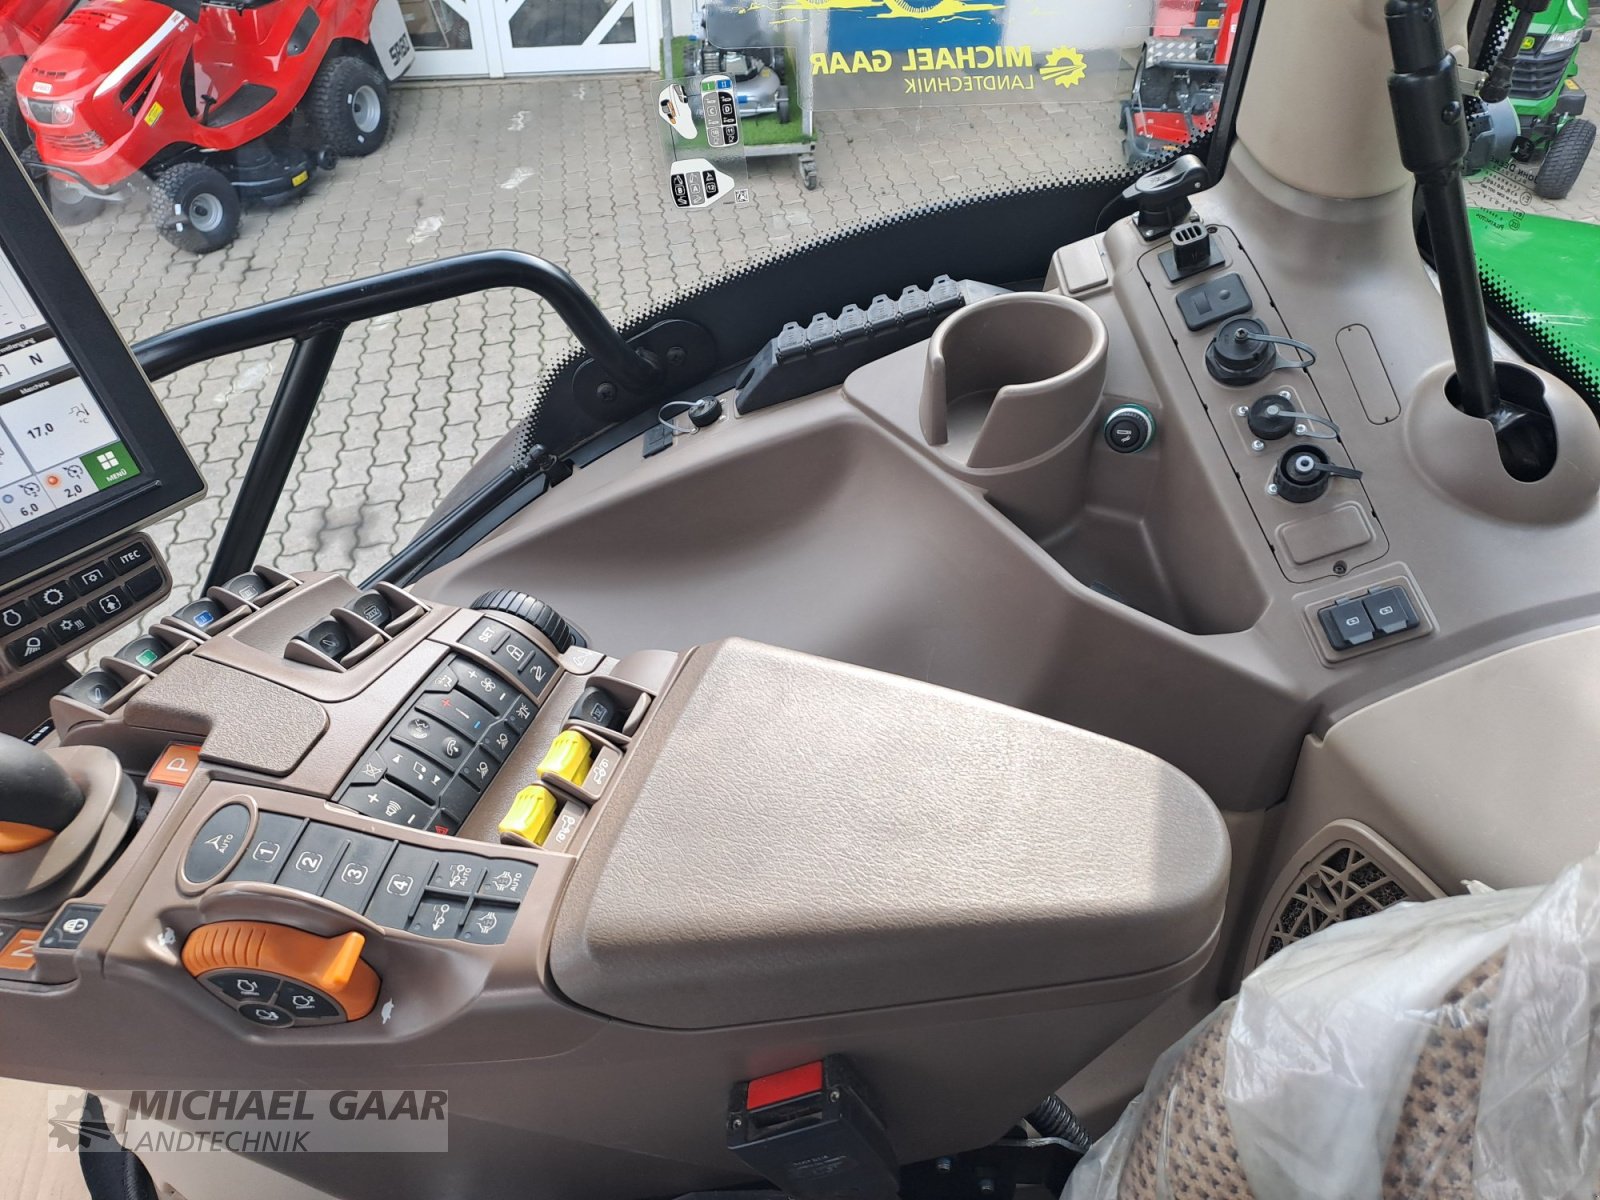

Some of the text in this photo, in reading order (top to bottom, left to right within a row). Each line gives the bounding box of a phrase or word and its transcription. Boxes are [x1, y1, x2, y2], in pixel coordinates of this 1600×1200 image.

[707, 184, 715, 192] 12
[29, 352, 43, 365] N
[20, 380, 50, 395] Maschine
[27, 423, 54, 439] 17,0
[106, 469, 127, 483] MENÜ
[64, 484, 82, 498] 2,0
[20, 503, 39, 517] 6,0
[478, 626, 495, 643] SET
[166, 757, 189, 772] P
[218, 833, 234, 854] AUTO
[302, 857, 318, 868] 2
[347, 868, 363, 879] 3
[459, 867, 472, 886] AUTO
[393, 880, 409, 891] 4
[510, 872, 522, 892] AUTO
